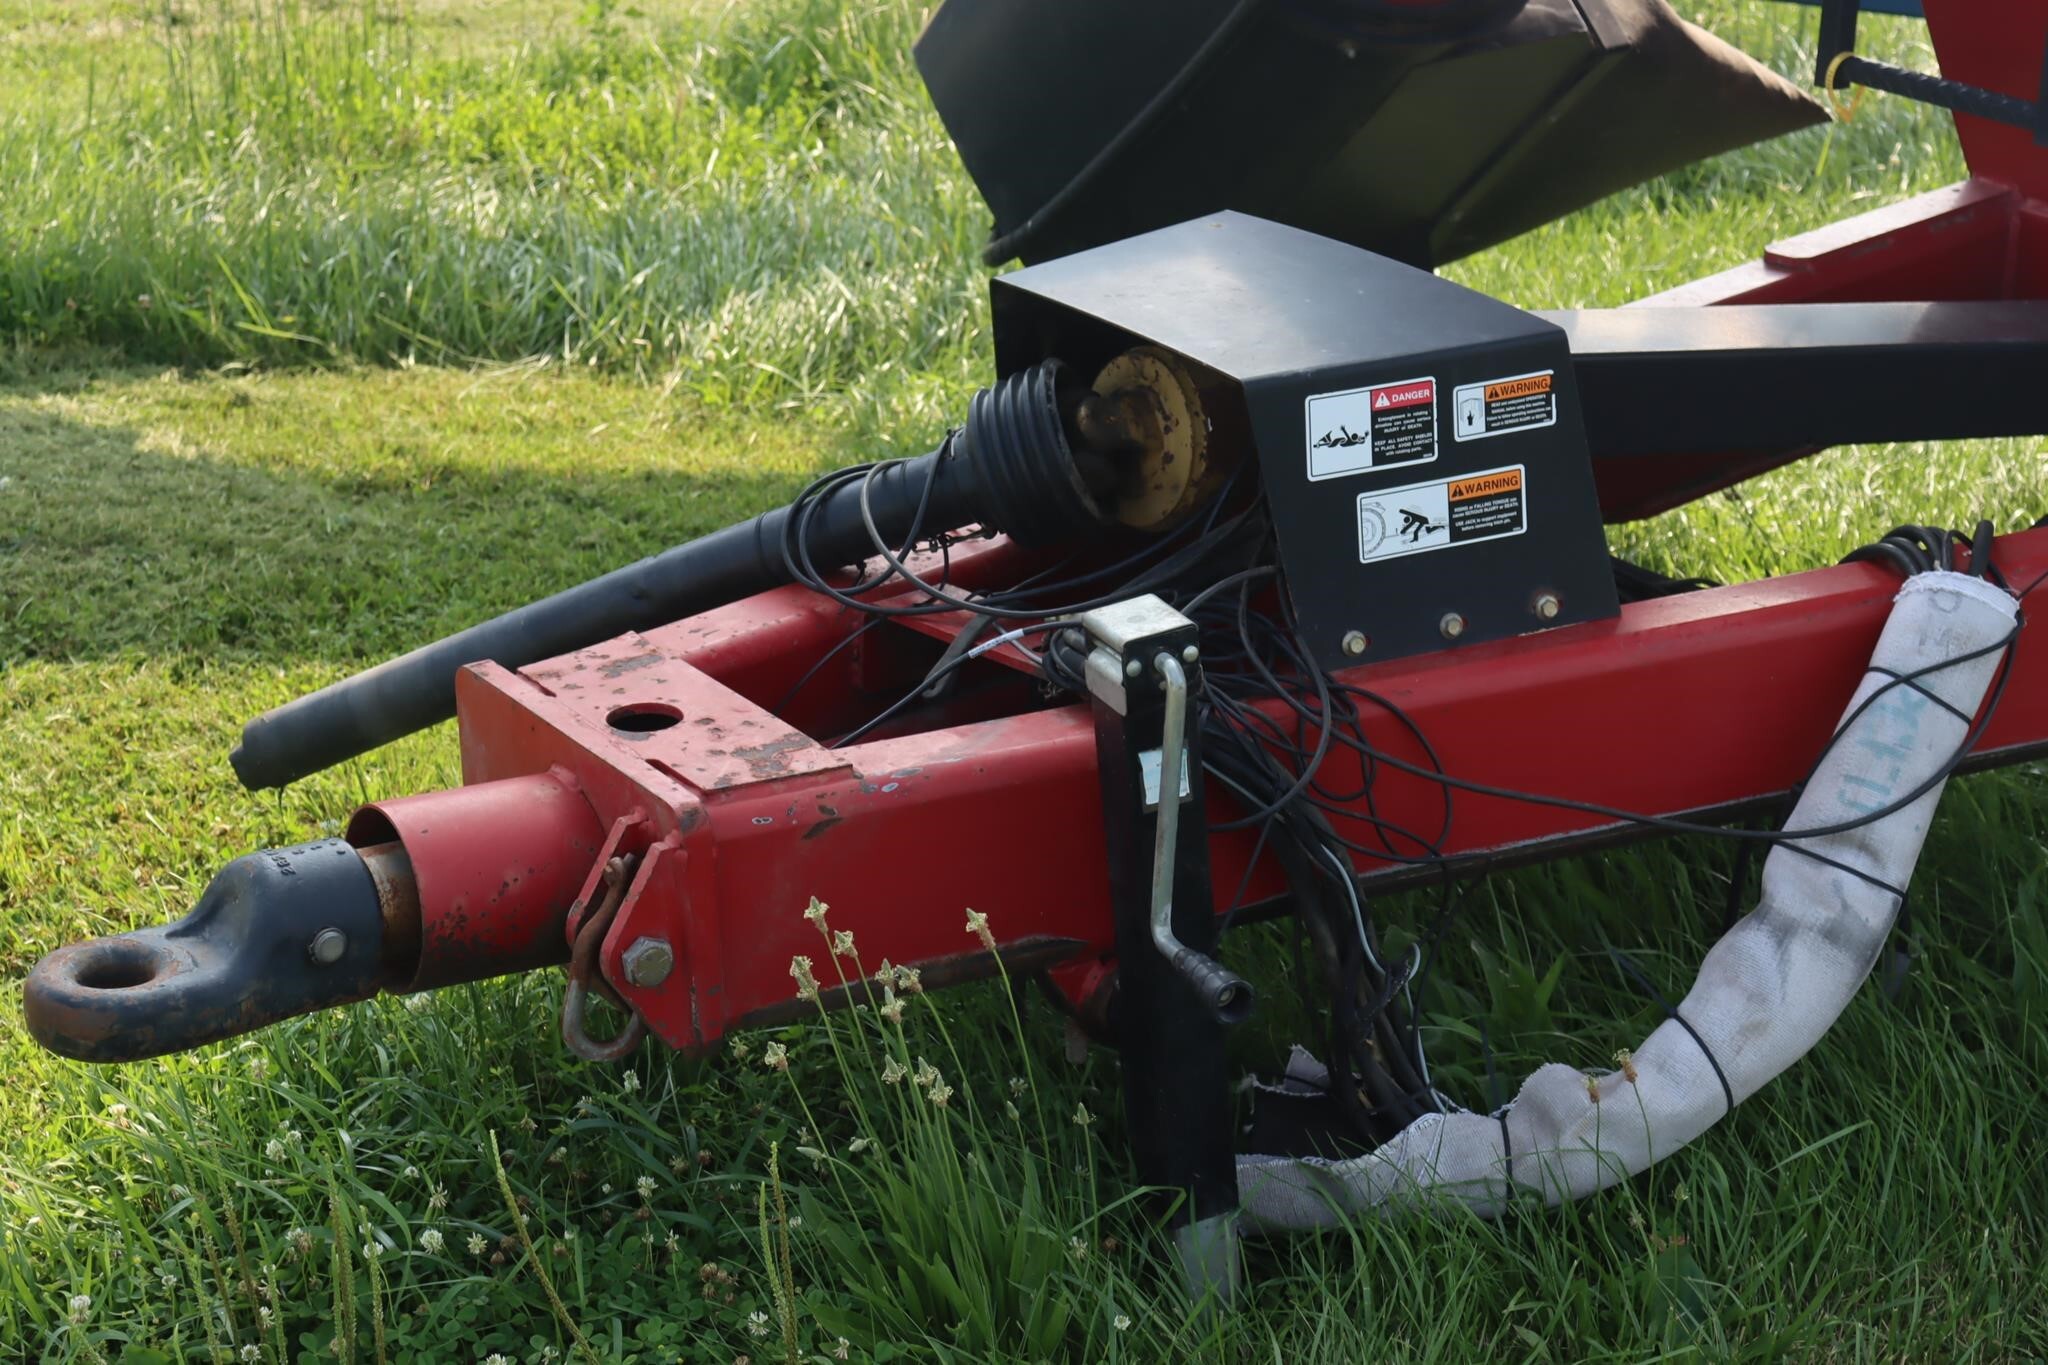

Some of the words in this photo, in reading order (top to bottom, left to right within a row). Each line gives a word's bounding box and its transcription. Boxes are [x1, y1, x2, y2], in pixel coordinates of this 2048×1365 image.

[1501, 378, 1548, 395] WARNING
[1392, 389, 1430, 402] DANGER
[1465, 476, 1518, 495] WARNING
